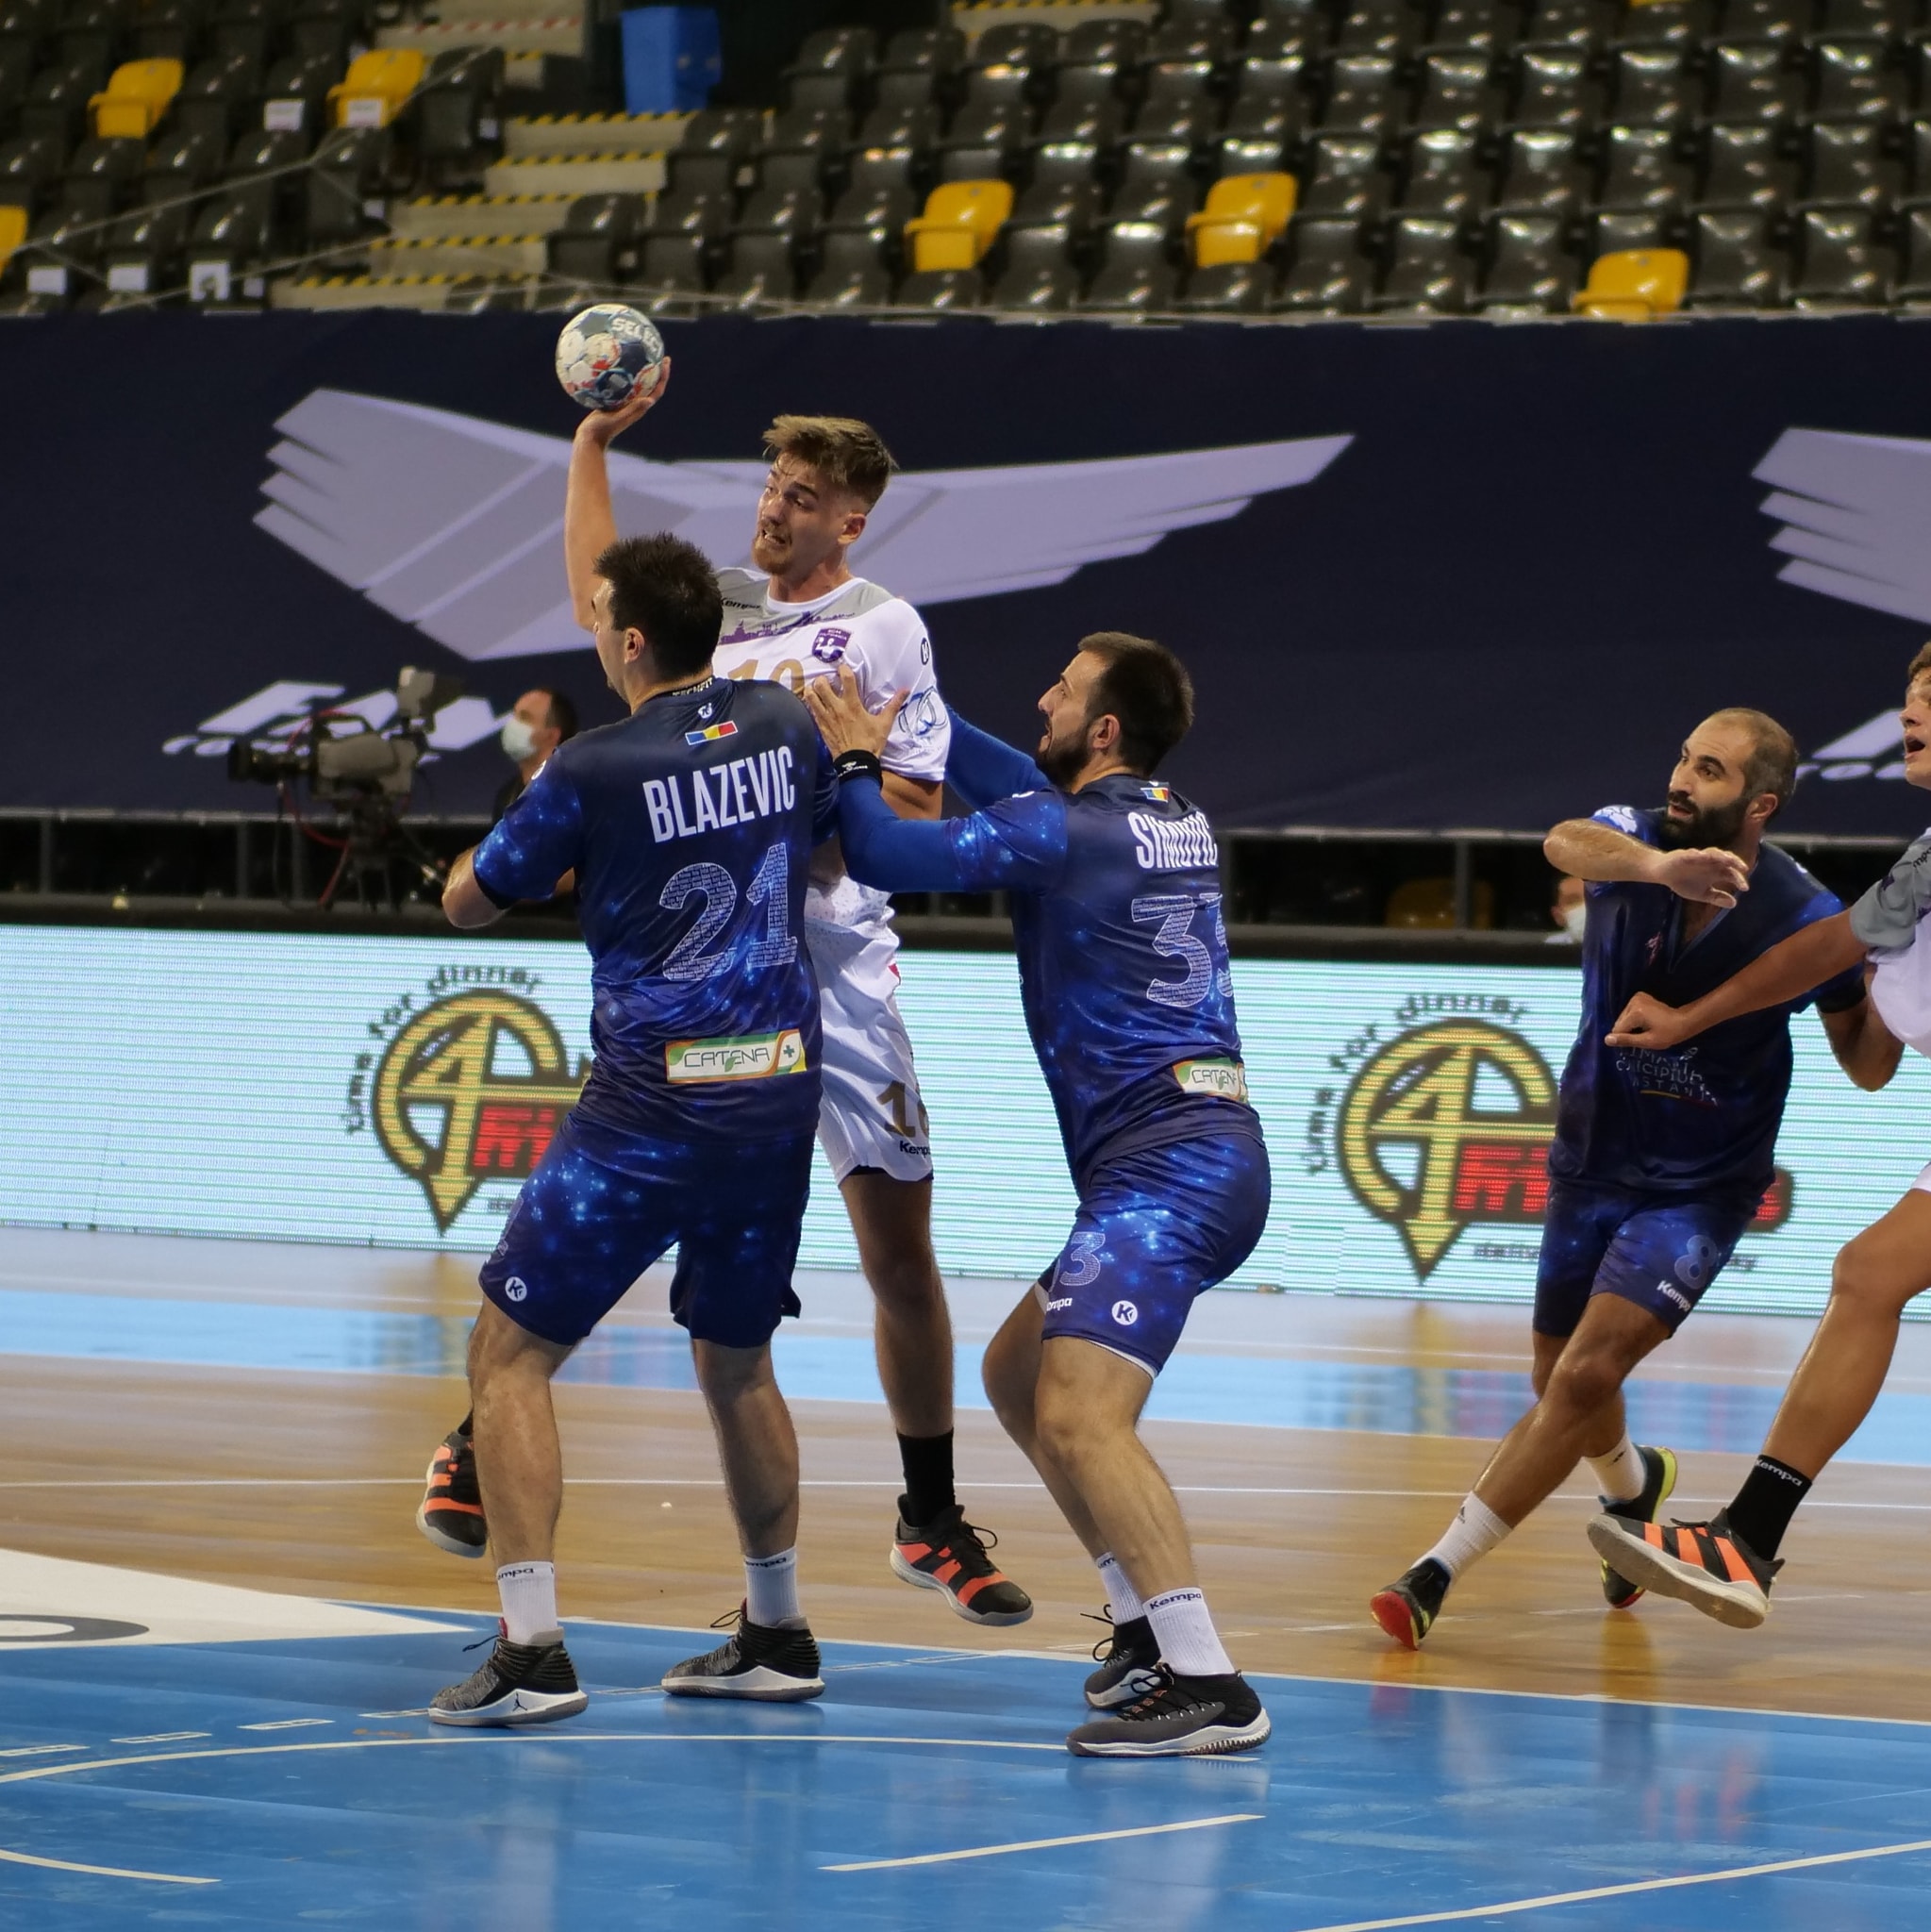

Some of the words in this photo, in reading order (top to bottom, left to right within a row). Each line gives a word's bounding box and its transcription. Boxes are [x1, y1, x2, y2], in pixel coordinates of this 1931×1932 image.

[642, 745, 795, 843] BLAZEVIC
[659, 841, 798, 982] 21
[684, 1047, 770, 1071] CATENA
[1673, 1234, 1718, 1290] 8
[1756, 1459, 1803, 1487] Kempa
[1149, 1592, 1202, 1610] Kempa
